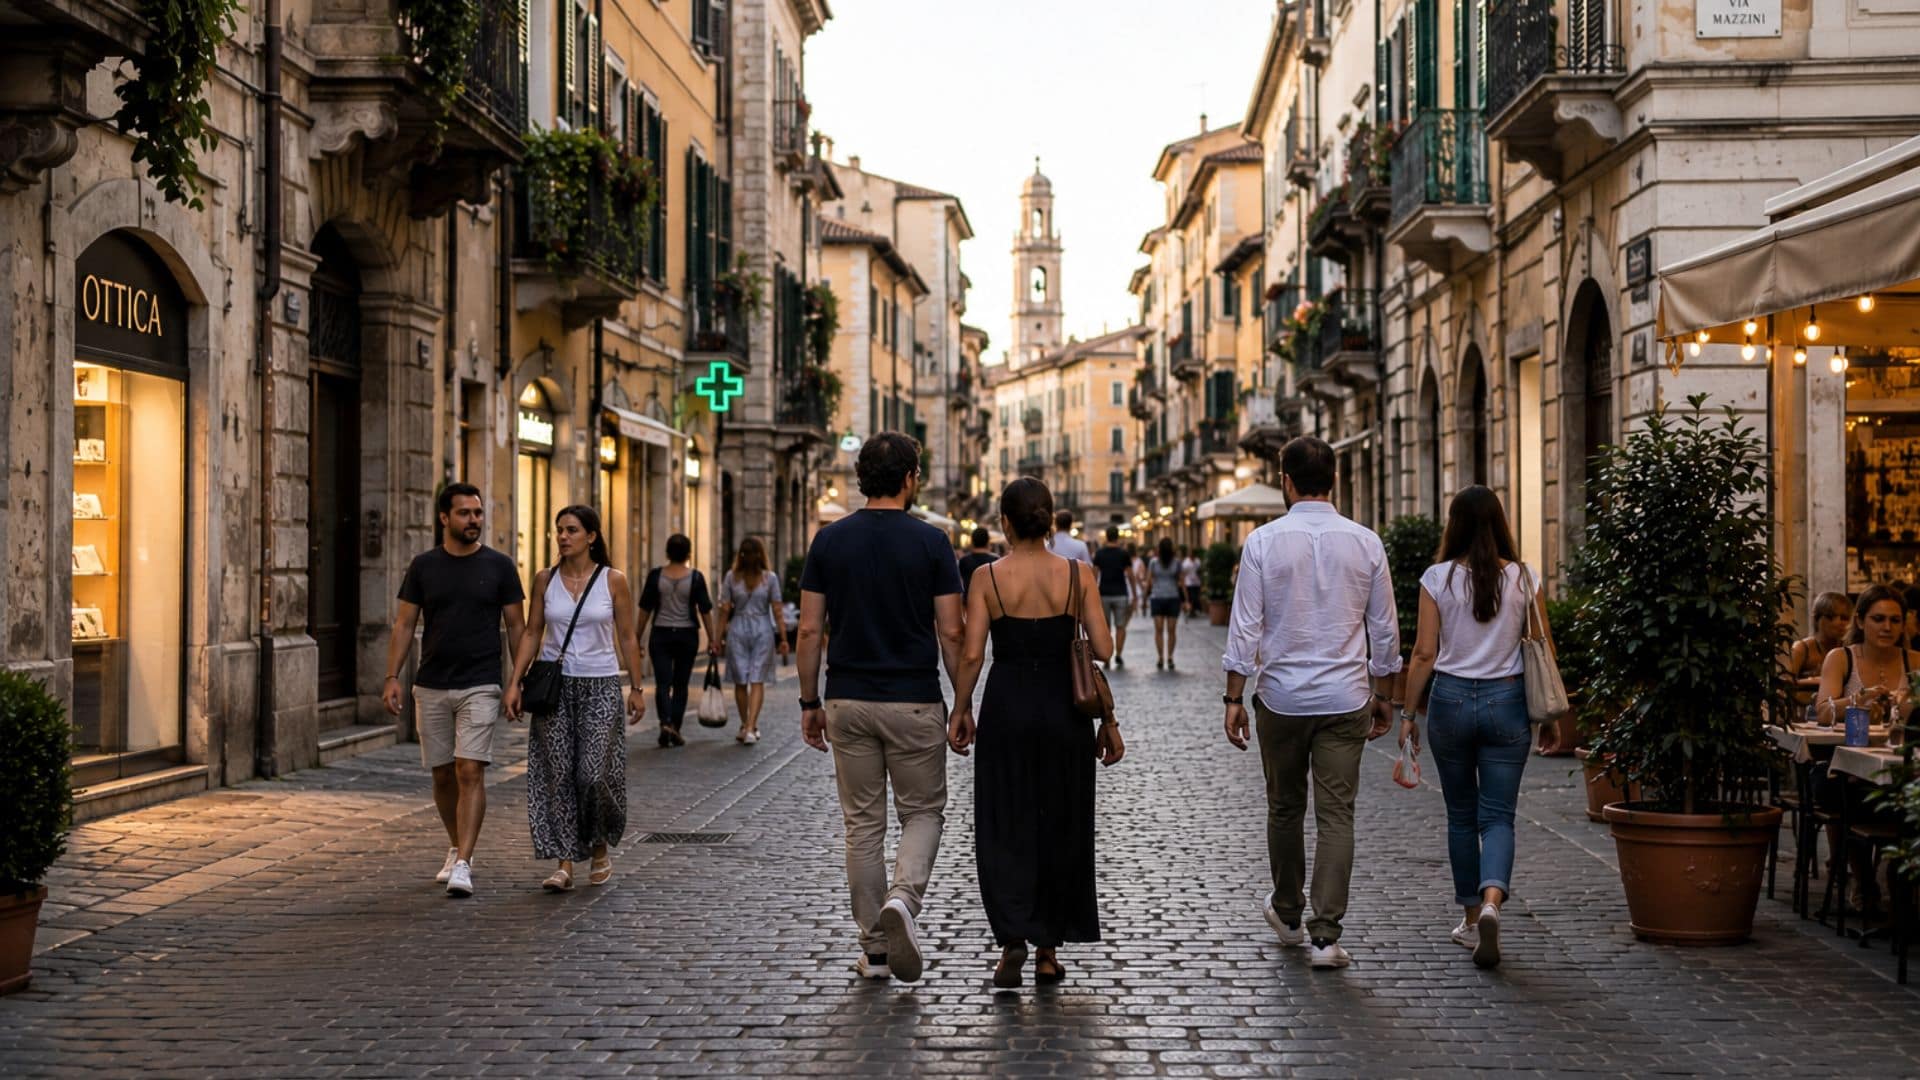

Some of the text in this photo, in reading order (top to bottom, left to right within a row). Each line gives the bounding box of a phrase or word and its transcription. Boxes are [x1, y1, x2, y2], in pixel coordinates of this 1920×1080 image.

[1729, 0, 1749, 8] VIA
[1713, 13, 1766, 24] MAZZINI
[83, 274, 162, 336] OTTICA
